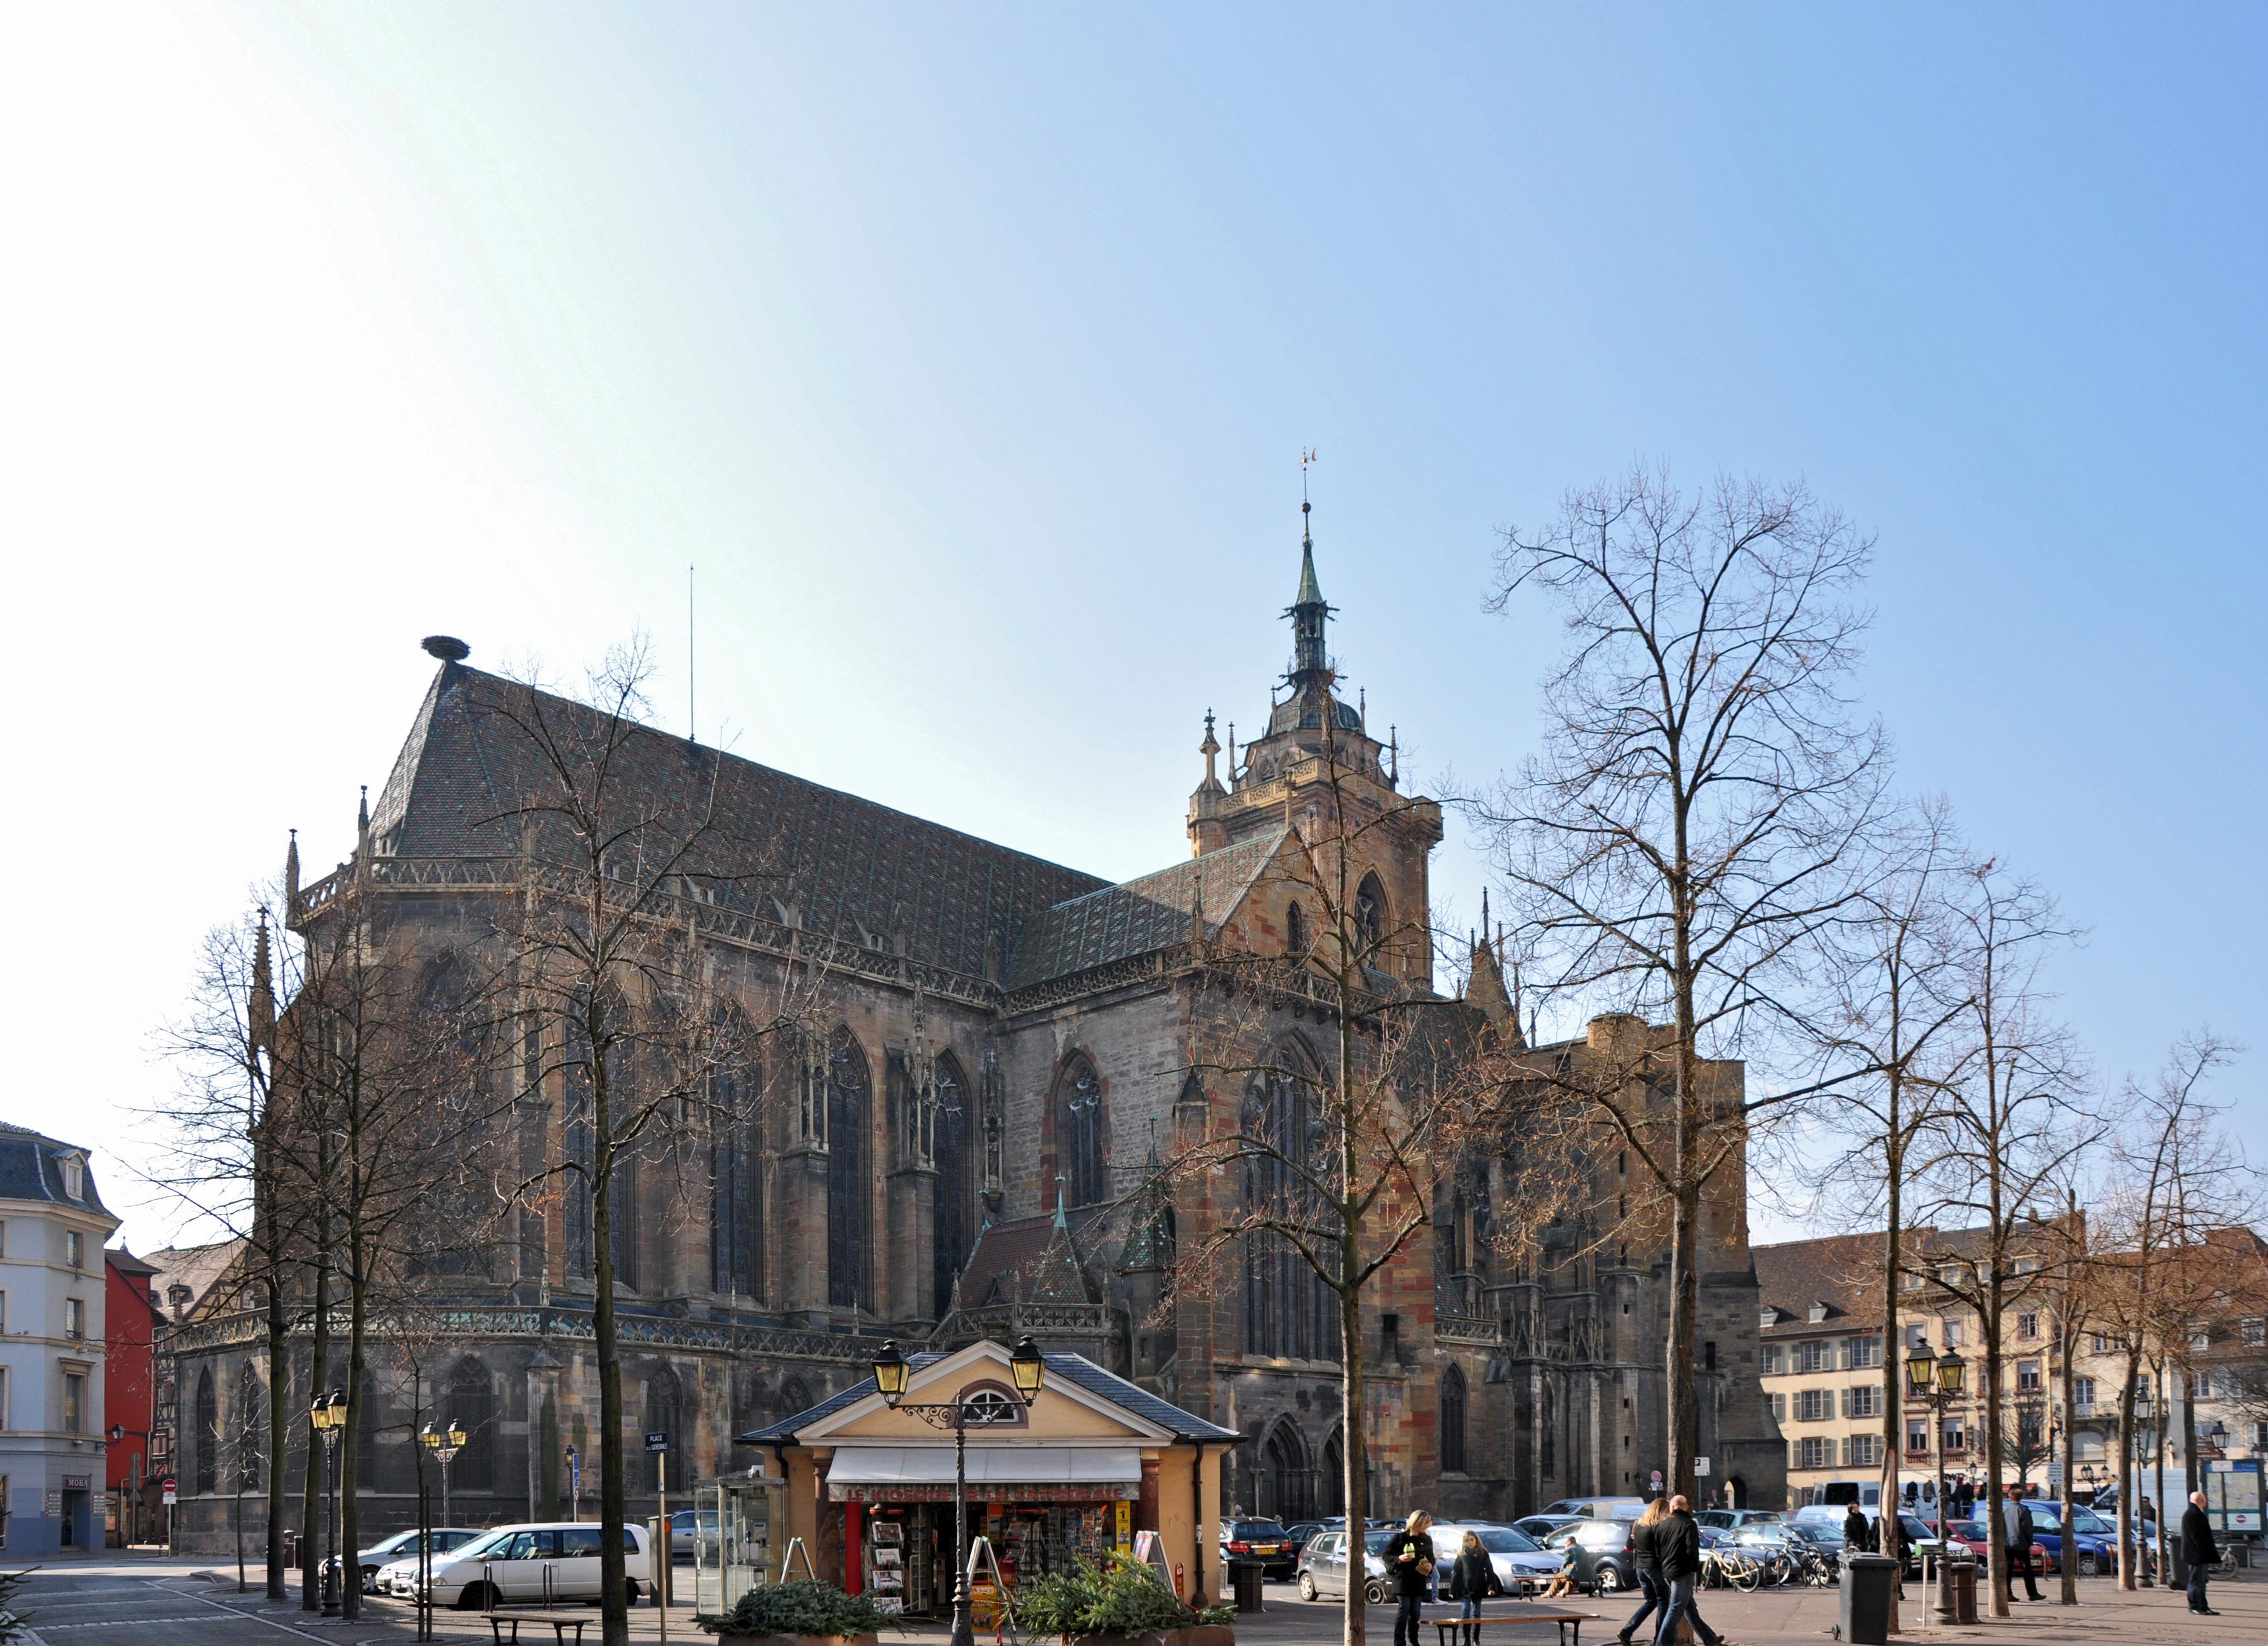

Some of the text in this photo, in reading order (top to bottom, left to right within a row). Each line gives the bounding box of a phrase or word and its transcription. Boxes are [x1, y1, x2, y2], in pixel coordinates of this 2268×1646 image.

[69, 1478, 87, 1487] MOBA
[847, 1489, 864, 1502] LE
[871, 1489, 951, 1501] KIOSQUE
[985, 1488, 1009, 1501] LA
